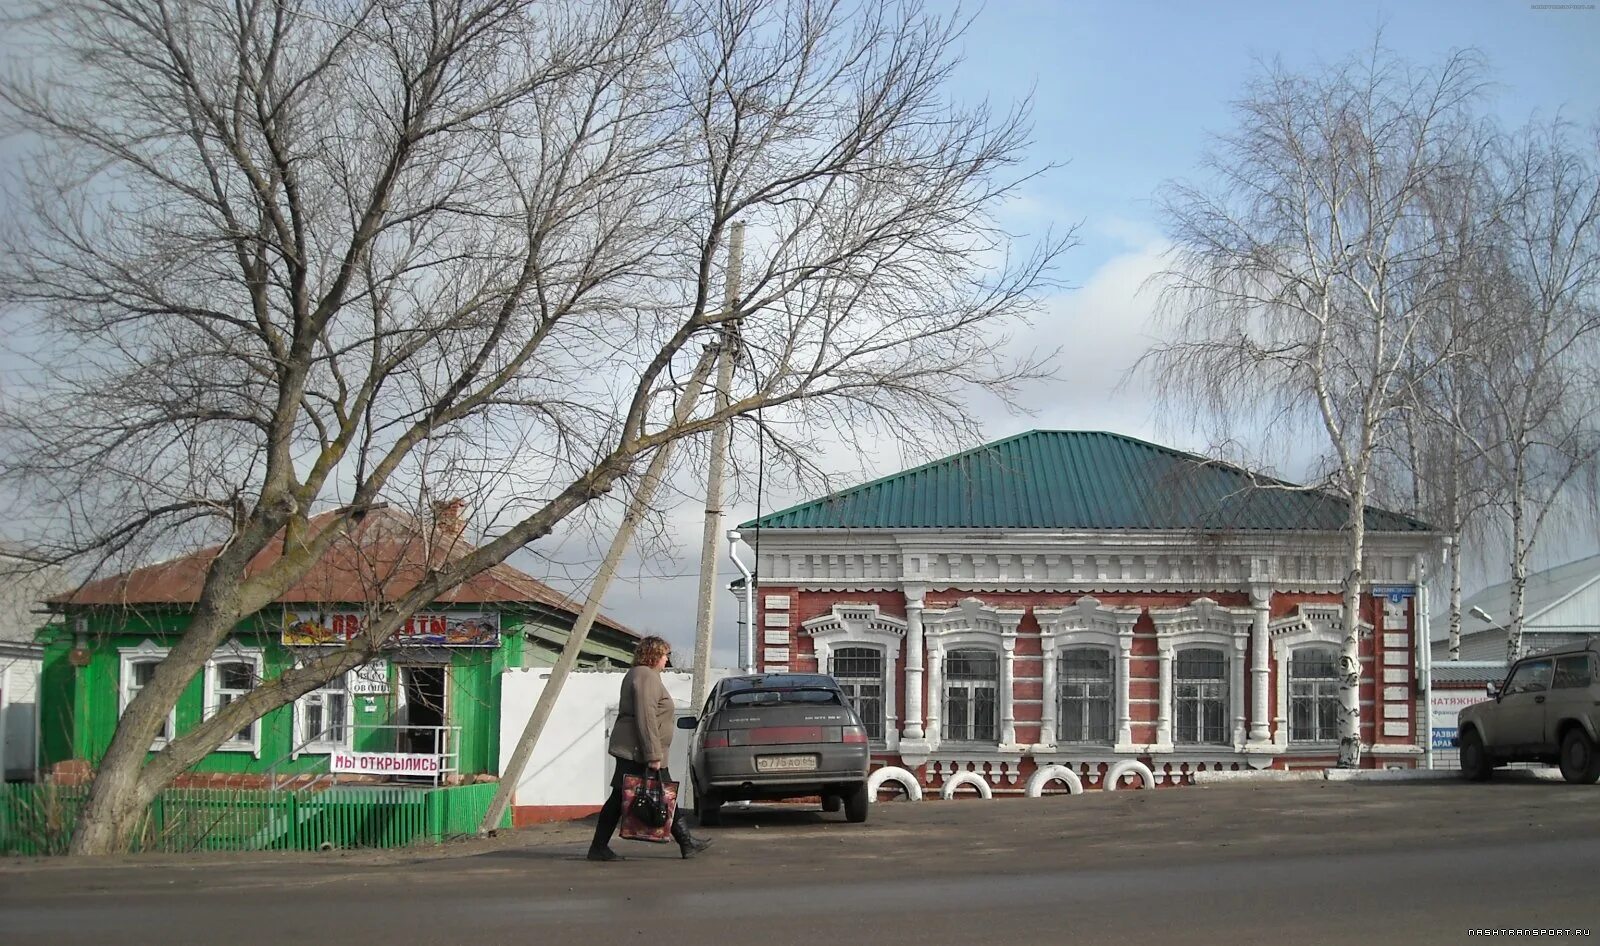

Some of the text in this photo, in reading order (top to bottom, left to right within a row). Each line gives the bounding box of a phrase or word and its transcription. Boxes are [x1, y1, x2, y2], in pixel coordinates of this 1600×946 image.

[332, 614, 447, 640] ПРКТЫ
[335, 755, 437, 771] МЫ ОТКРЫЛИСЬ
